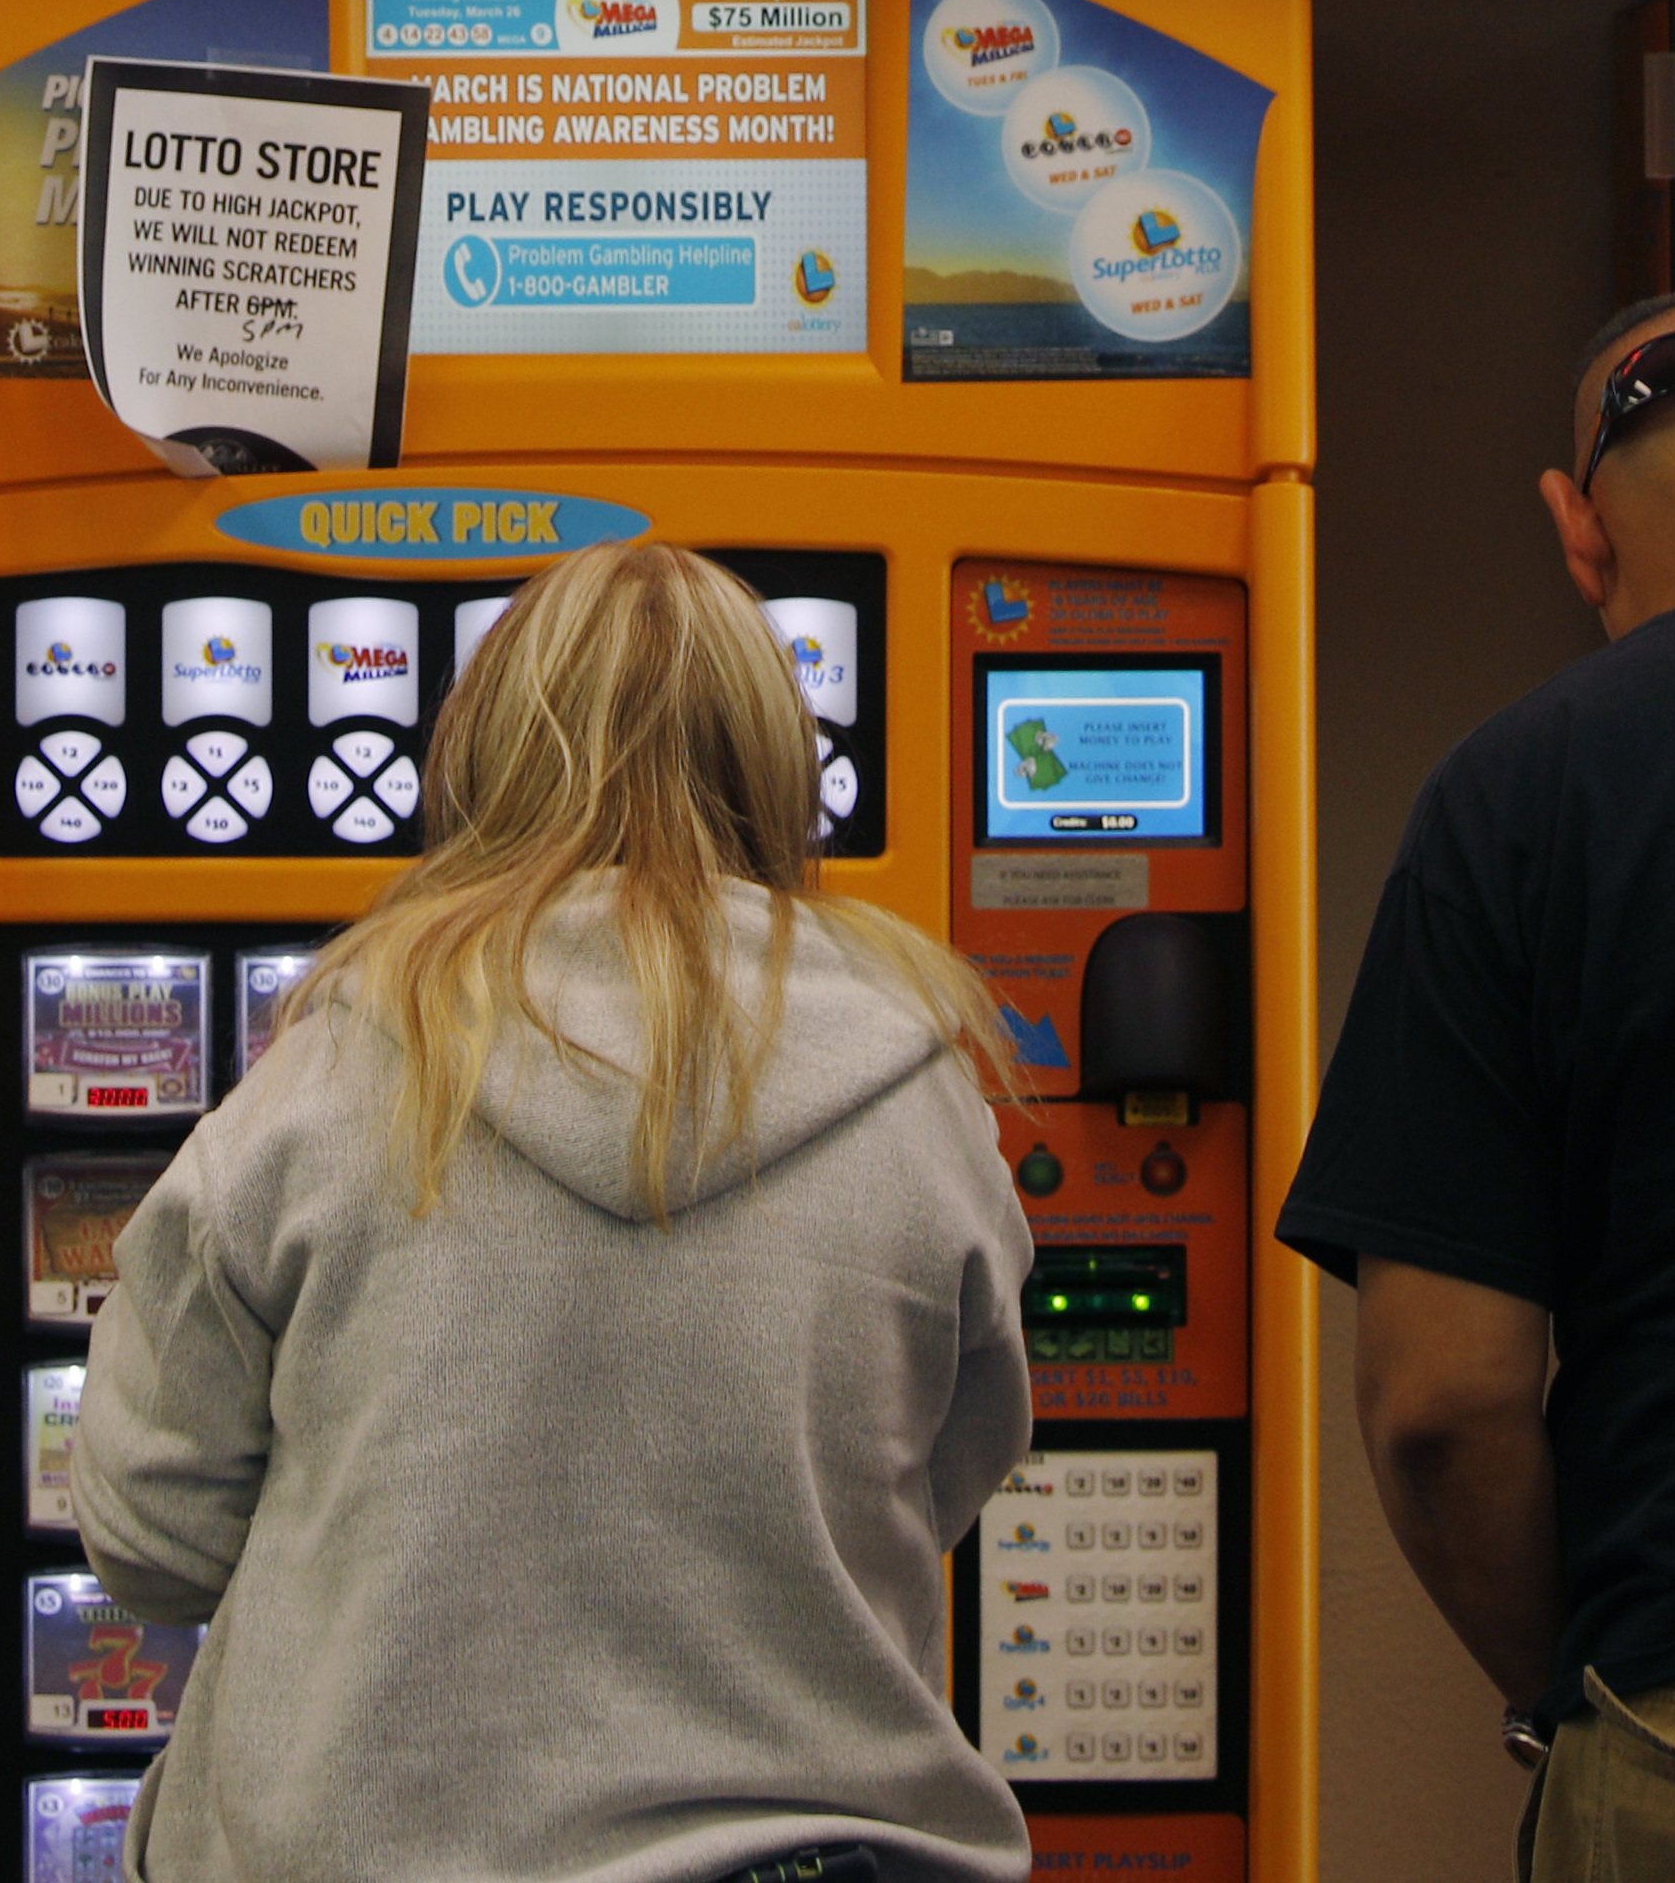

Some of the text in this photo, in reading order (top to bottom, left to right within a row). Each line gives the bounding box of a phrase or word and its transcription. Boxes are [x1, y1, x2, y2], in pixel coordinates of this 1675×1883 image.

[466, 6, 503, 17] March
[596, 0, 658, 26] MEGA
[708, 6, 844, 30] $75 Million
[403, 28, 443, 40] 14 22
[731, 35, 844, 49] Estimated Jackpot
[973, 26, 1034, 53] MEGA
[411, 72, 826, 104] ARCH IS NATIONAL PROBLEM
[427, 114, 835, 144] AMBLING AWARENESS MONTH!
[124, 131, 242, 177] LOTTO
[256, 141, 381, 189] STORE
[1049, 165, 1117, 185] WED SAT
[134, 187, 362, 229] DUE TO HIGH JACKPOT,
[447, 190, 773, 222] PLAY RESPONSIBLY
[133, 220, 359, 260] WE WILL NOT REDEEM
[508, 243, 754, 271] Problem Gambling Helpline
[1092, 246, 1222, 282] SuperLotto
[127, 252, 357, 293] WINNING SCRATCHERS
[508, 275, 670, 297] 1-800-GAMBLER
[175, 288, 239, 315] AFTER
[1131, 293, 1204, 315] WED SAT
[786, 316, 842, 334] calottery
[176, 343, 289, 372] We Apologize
[138, 366, 325, 402] For Any Inconvenience.
[300, 500, 562, 549] QUICK PICK
[347, 646, 408, 669] MEGA
[173, 661, 262, 681] SuperLotto
[171, 778, 260, 793] $2 $5
[204, 817, 229, 830] $10
[128, 982, 174, 1002] PLAY
[1093, 1851, 1193, 1872] PLAYSLIP
